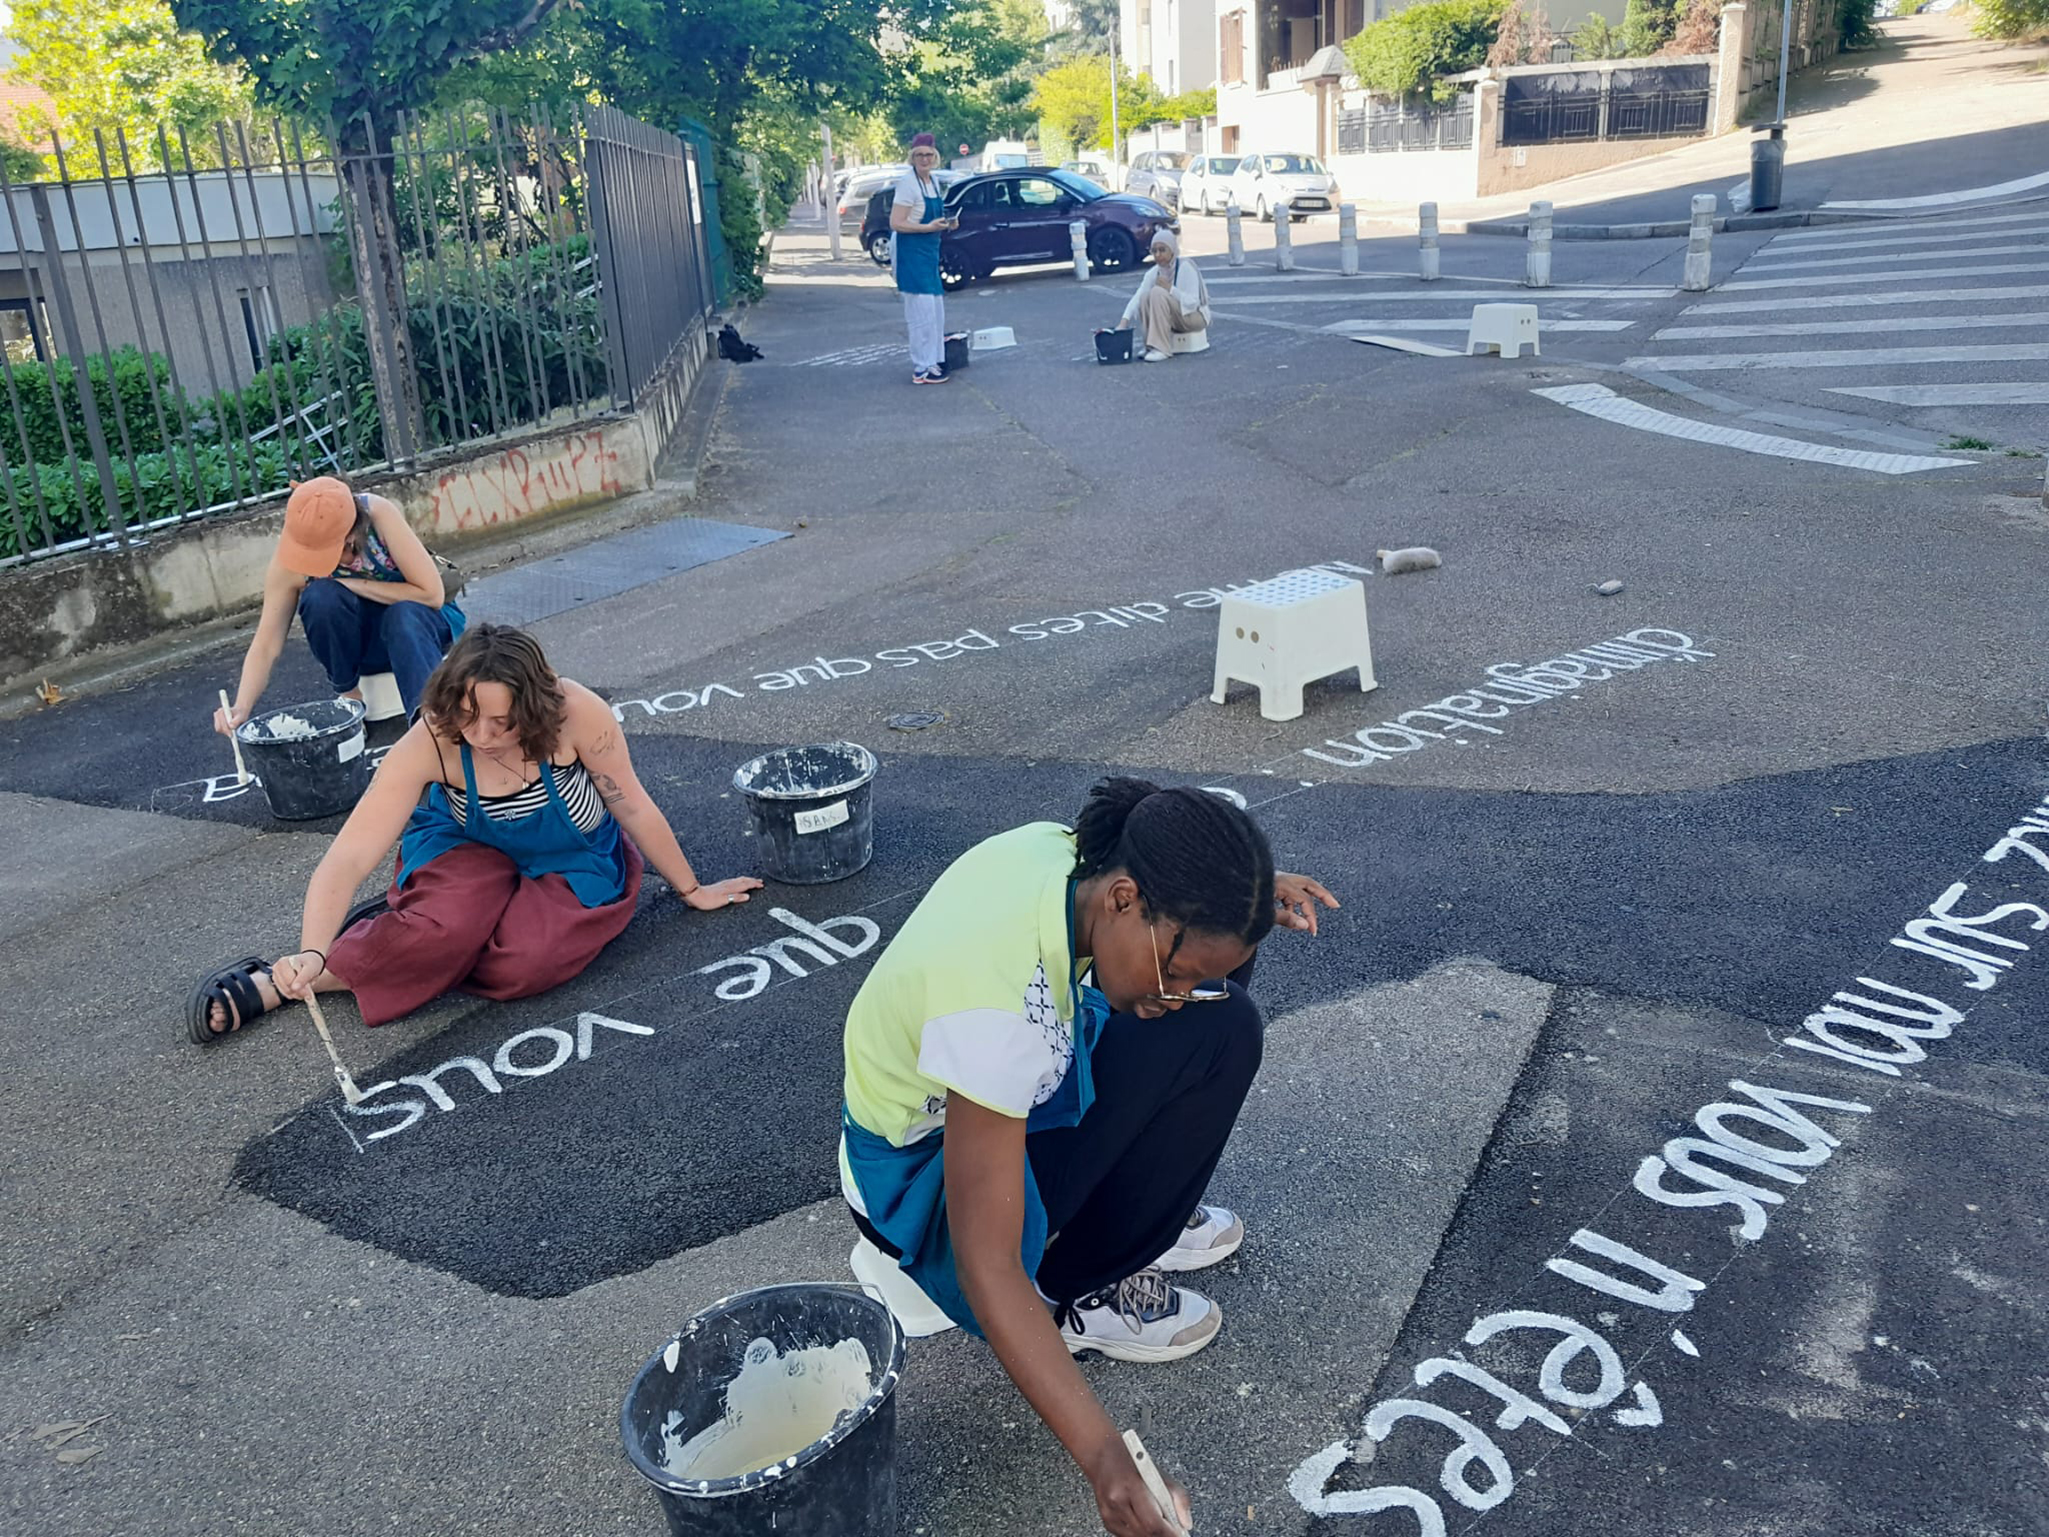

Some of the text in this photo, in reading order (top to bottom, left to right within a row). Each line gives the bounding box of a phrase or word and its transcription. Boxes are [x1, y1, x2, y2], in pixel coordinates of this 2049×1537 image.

[875, 629, 1000, 668] pas
[1008, 601, 1170, 641] dites
[609, 682, 745, 723] vou
[753, 656, 872, 691] que
[700, 907, 881, 1000] que
[1889, 882, 2049, 990] sur
[343, 1012, 655, 1140] vous
[1633, 1081, 1871, 1241] vous
